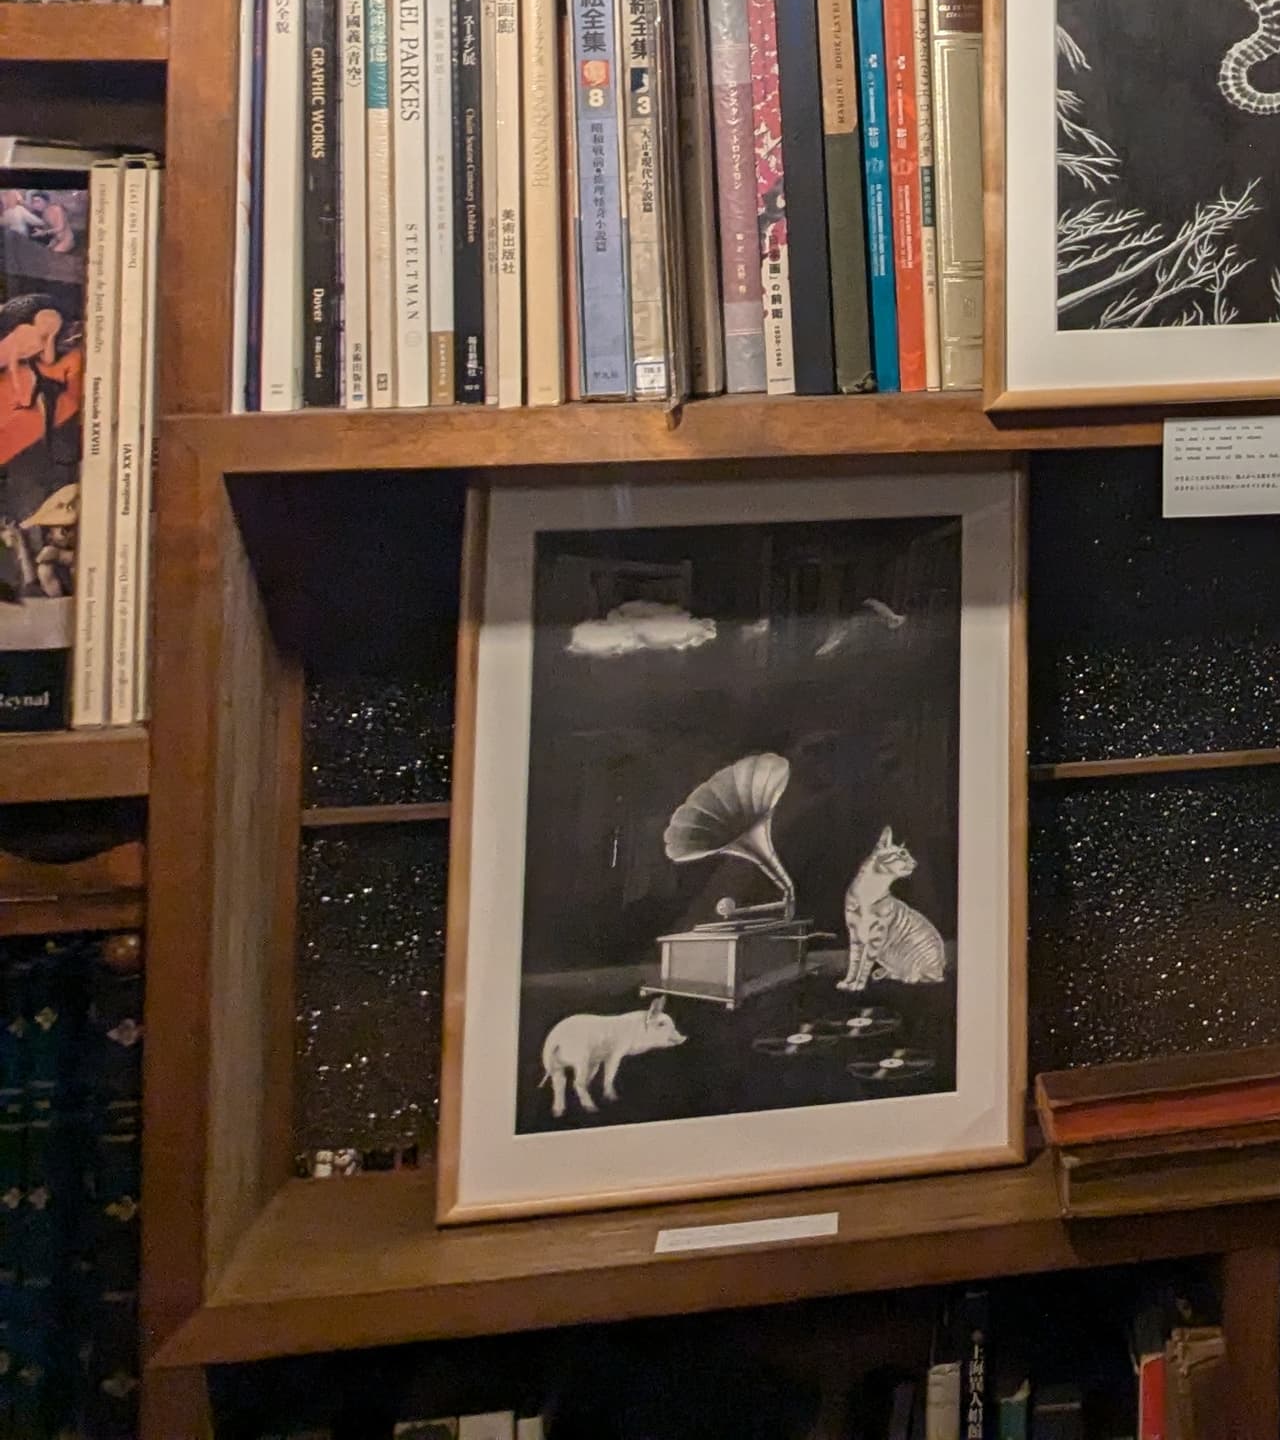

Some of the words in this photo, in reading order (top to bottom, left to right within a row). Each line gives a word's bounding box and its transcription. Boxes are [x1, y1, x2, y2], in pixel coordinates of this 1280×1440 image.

[461, 14, 477, 66] スーチン展
[311, 47, 325, 106] GRAPHIC
[399, 37, 420, 122] PARKES
[588, 88, 604, 108] 8
[637, 95, 650, 114] 3
[311, 109, 326, 159] WORKS
[501, 208, 516, 275] 美術出版社
[405, 223, 420, 321] STELTMAN
[313, 287, 325, 323] Dover
[91, 421, 101, 456] XXVIII
[122, 443, 132, 470] XXVI
